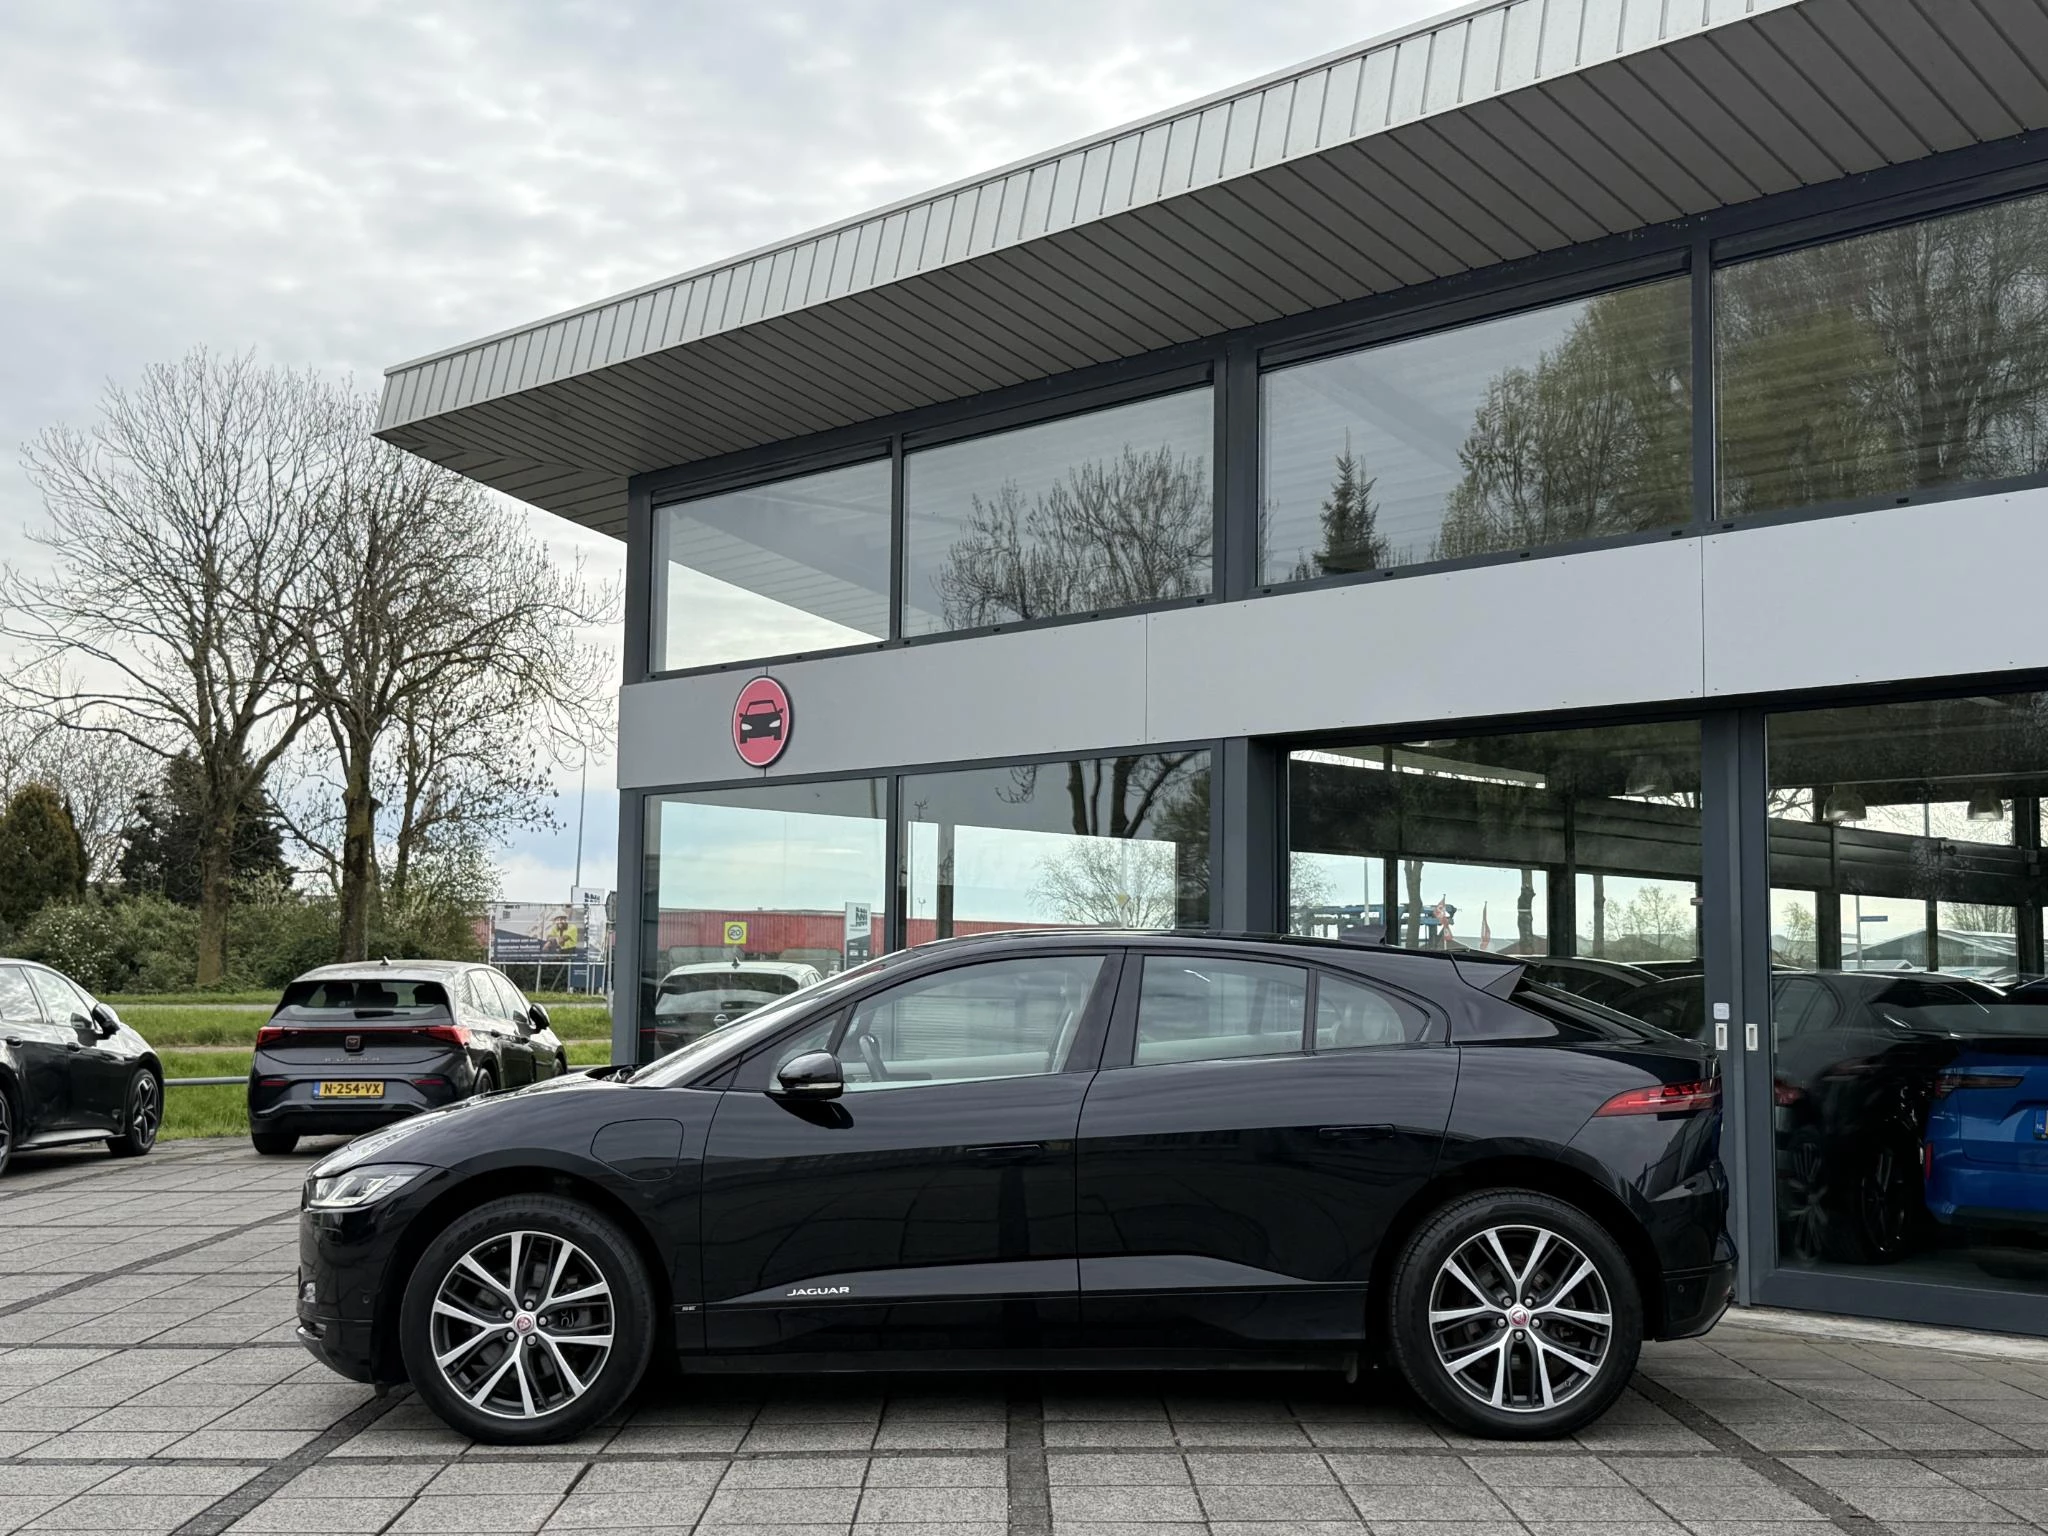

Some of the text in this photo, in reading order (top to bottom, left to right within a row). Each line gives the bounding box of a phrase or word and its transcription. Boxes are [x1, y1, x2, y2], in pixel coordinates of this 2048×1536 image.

[730, 929, 741, 937] 20
[324, 1083, 381, 1094] N-254-VX
[787, 1286, 850, 1297] JAGUAR
